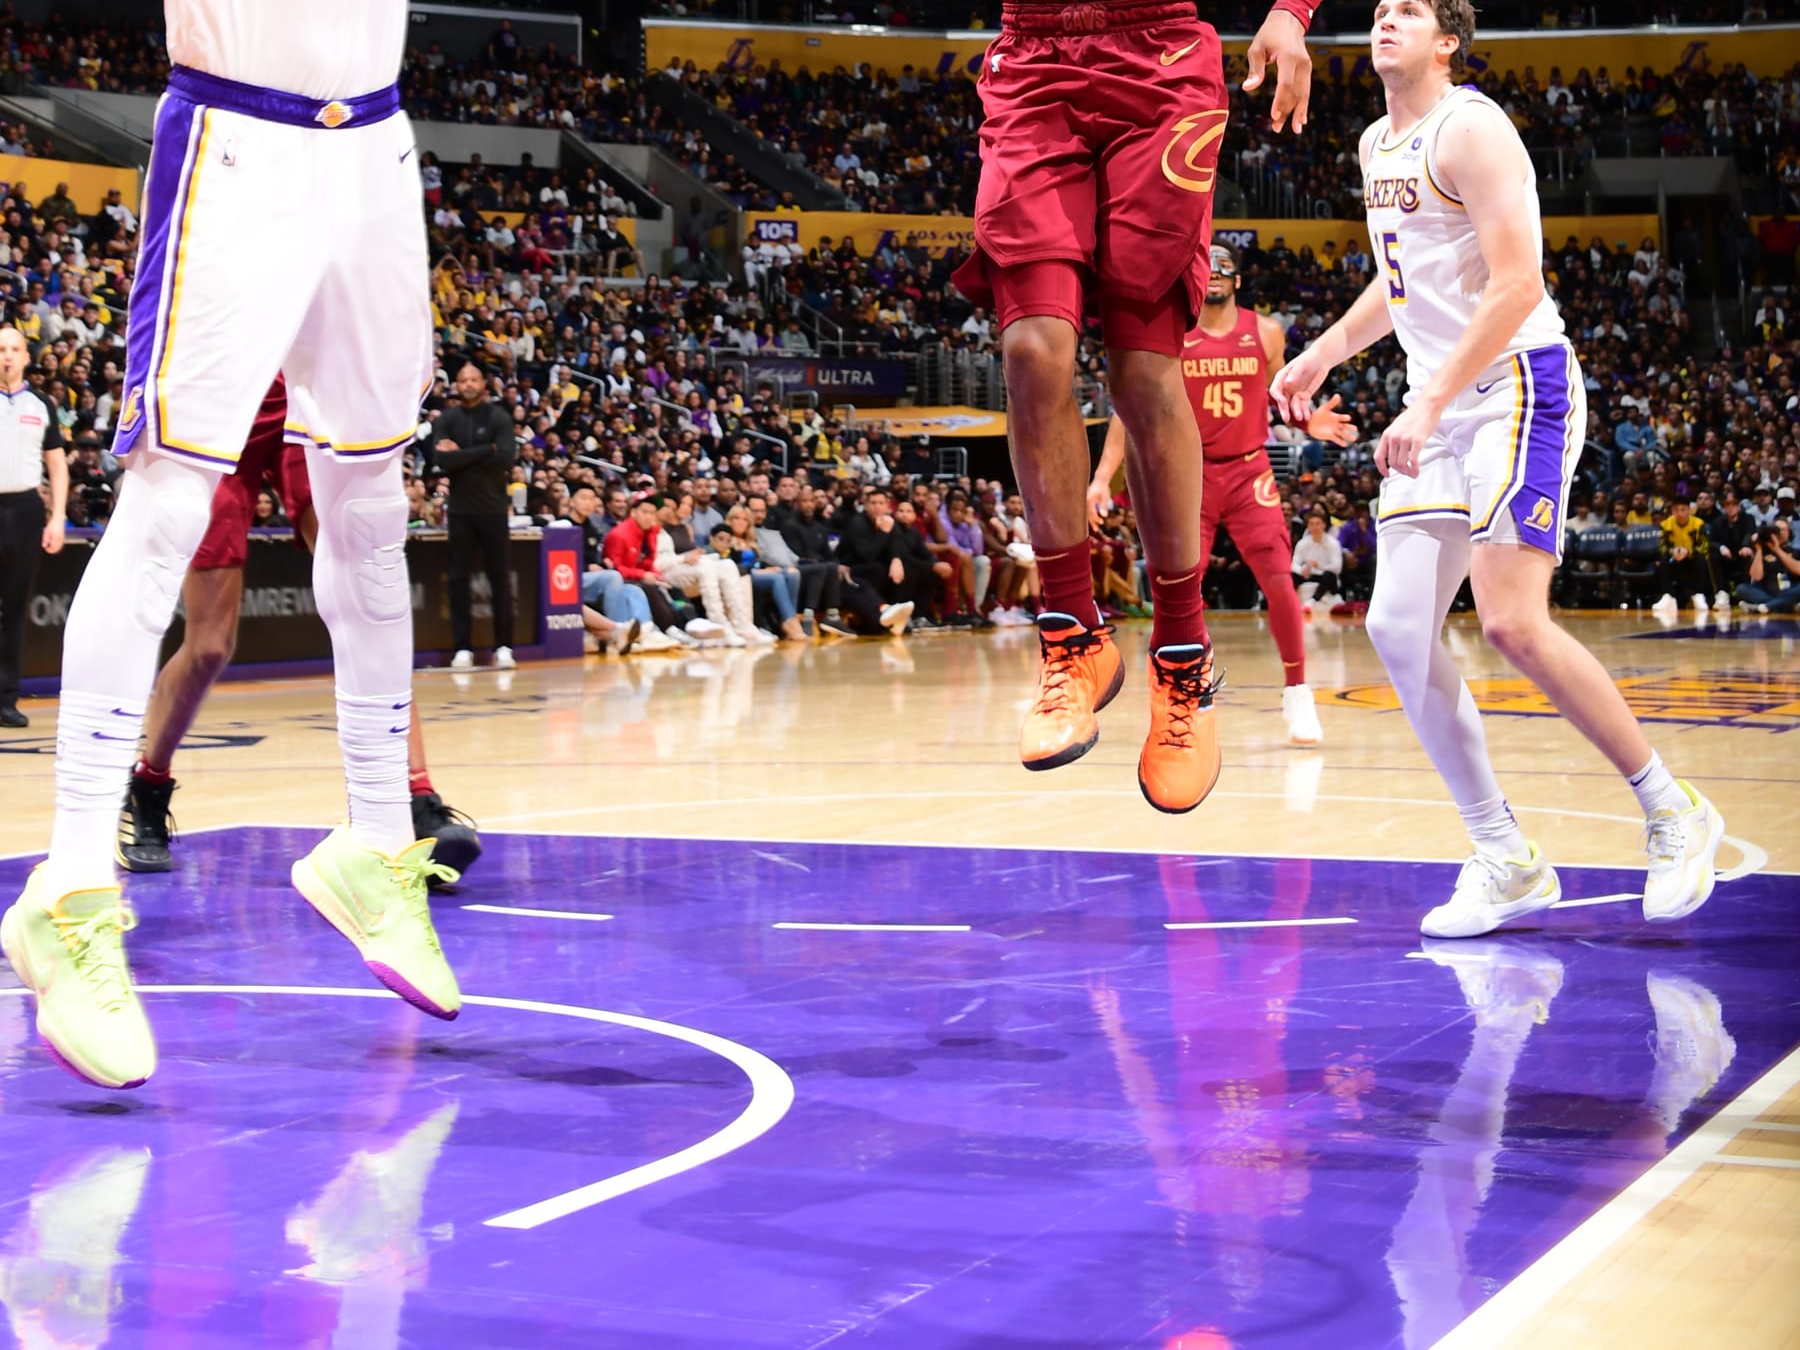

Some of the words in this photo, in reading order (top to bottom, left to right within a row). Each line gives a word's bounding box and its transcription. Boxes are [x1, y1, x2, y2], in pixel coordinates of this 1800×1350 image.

[1062, 10, 1106, 31] CAVS
[758, 222, 794, 240] 105
[1183, 357, 1258, 378] CLEVELAND
[818, 370, 874, 386] ULTRA
[1203, 381, 1243, 418] 45
[546, 613, 584, 630] TOYOTA
